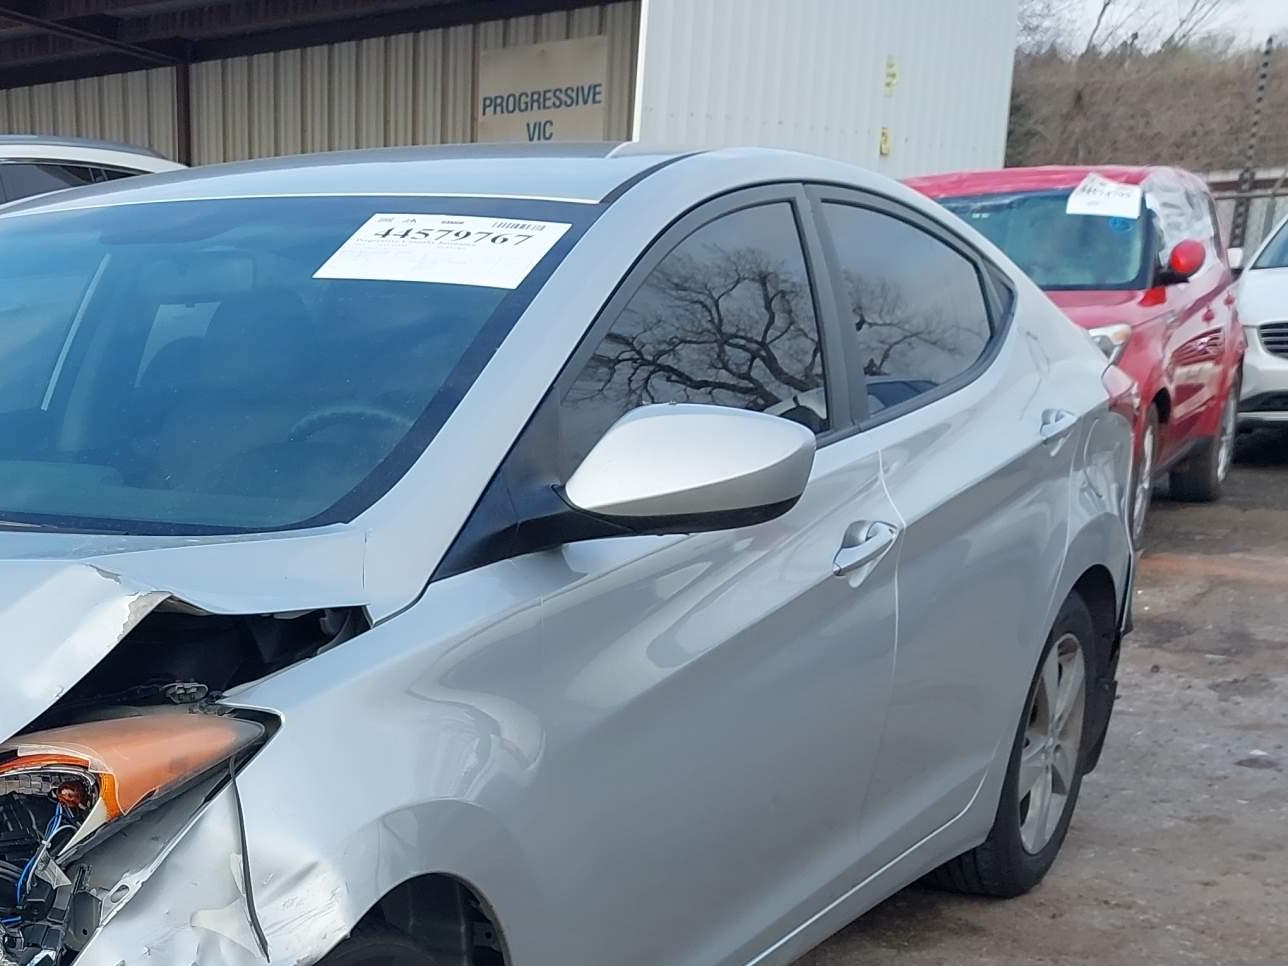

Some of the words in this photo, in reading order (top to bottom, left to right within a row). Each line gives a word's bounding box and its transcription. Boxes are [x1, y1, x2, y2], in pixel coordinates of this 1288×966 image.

[482, 83, 601, 116] PROGRESSIVE
[526, 120, 554, 142] VIC
[374, 227, 534, 246] 44579767
